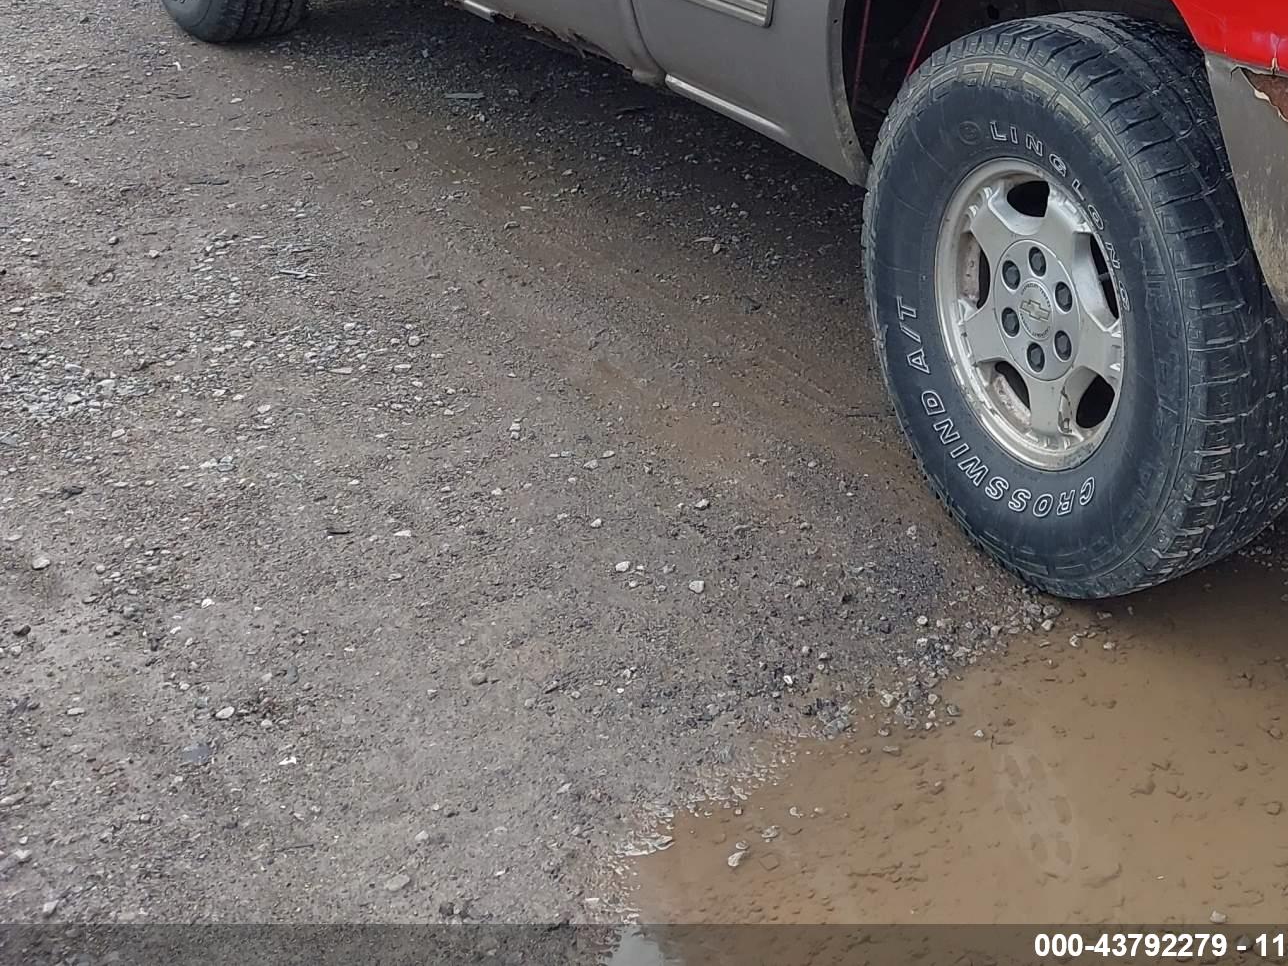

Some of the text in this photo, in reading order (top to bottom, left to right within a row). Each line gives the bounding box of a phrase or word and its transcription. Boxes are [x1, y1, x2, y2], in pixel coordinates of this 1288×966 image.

[989, 120, 1131, 312] LINGLONG
[896, 296, 1095, 517] CROSSWIND A/T
